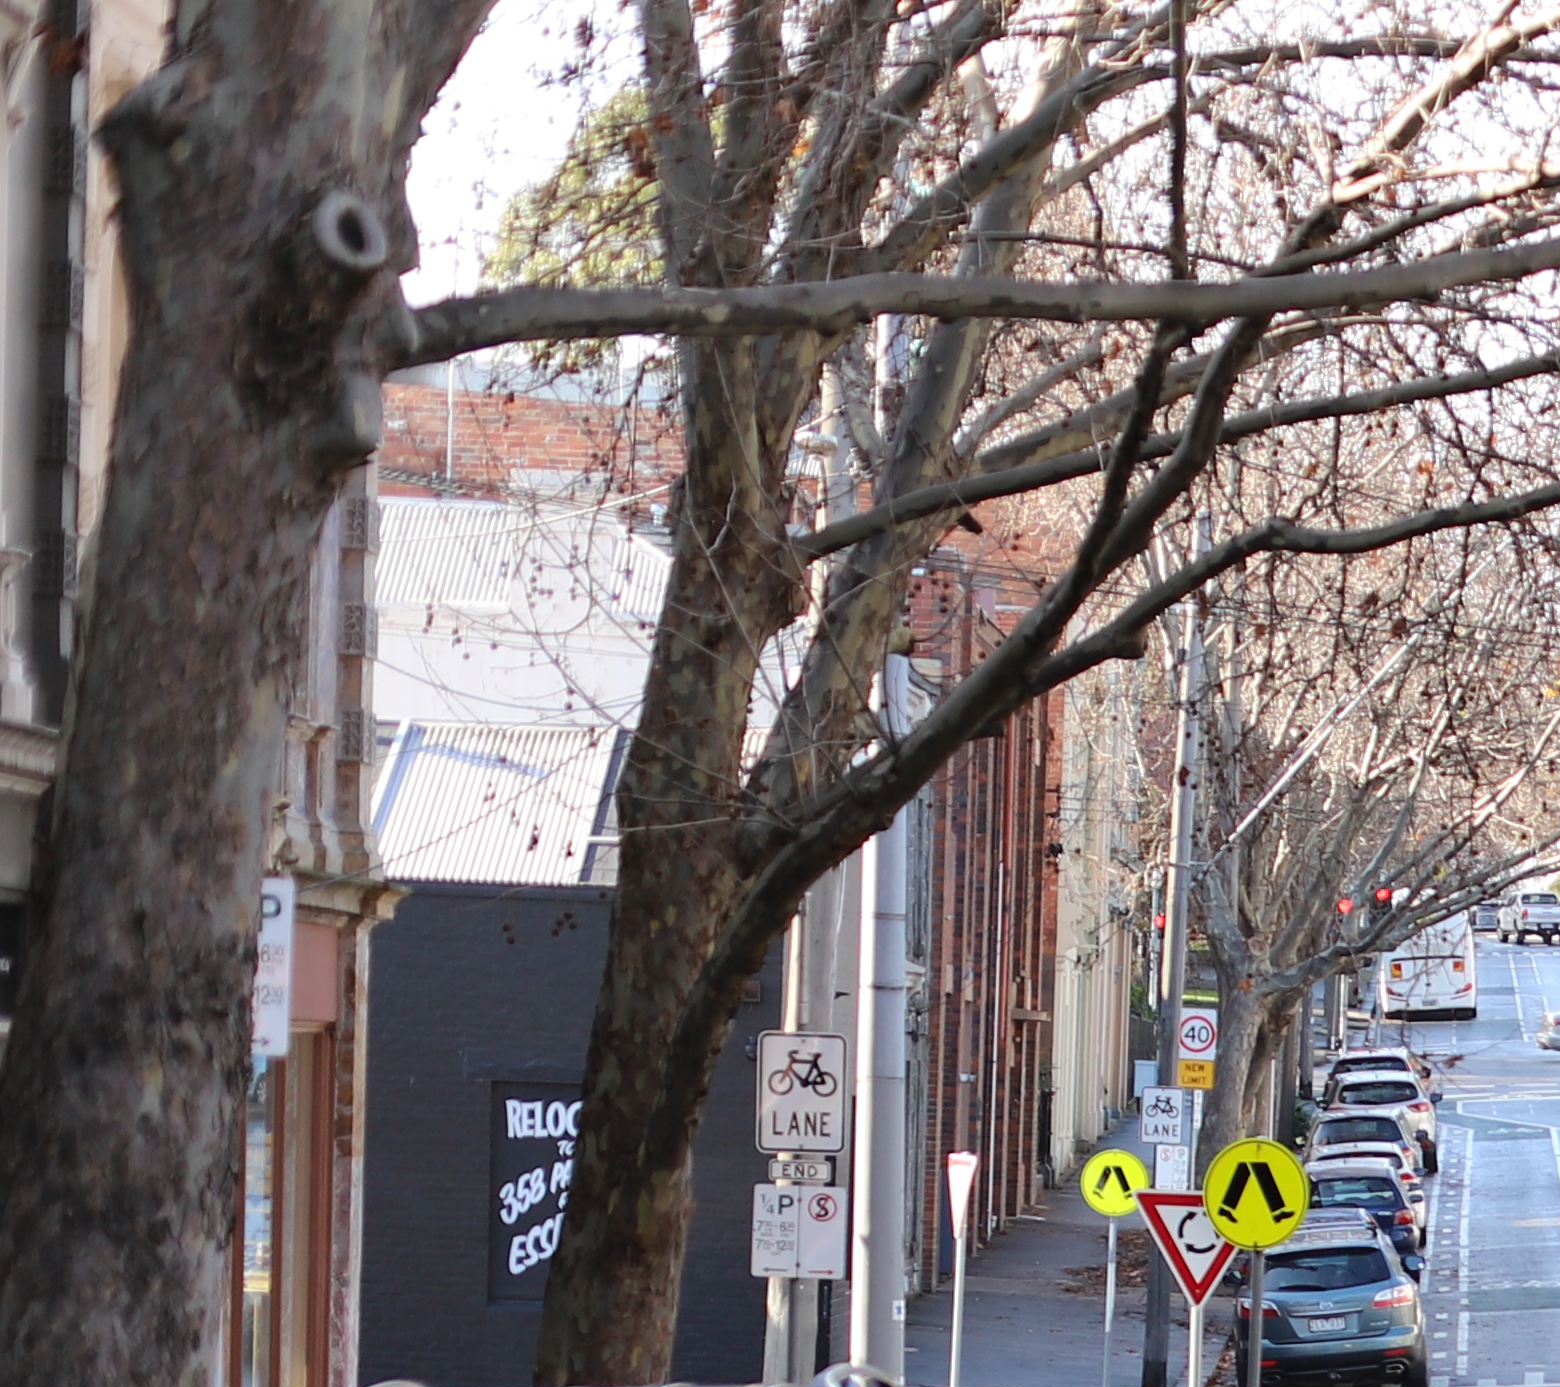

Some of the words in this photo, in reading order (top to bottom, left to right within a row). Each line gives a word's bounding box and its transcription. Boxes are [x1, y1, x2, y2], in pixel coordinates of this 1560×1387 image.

[1184, 1025, 1210, 1044] 40
[1184, 1063, 1205, 1073] NEW
[1181, 1075, 1207, 1085] LIMIT
[505, 1099, 584, 1139] RELOC
[772, 1110, 831, 1137] LANE
[1143, 1123, 1179, 1137] LANE
[781, 1163, 819, 1178] END
[499, 1167, 548, 1225] 358
[550, 1158, 575, 1194] PA
